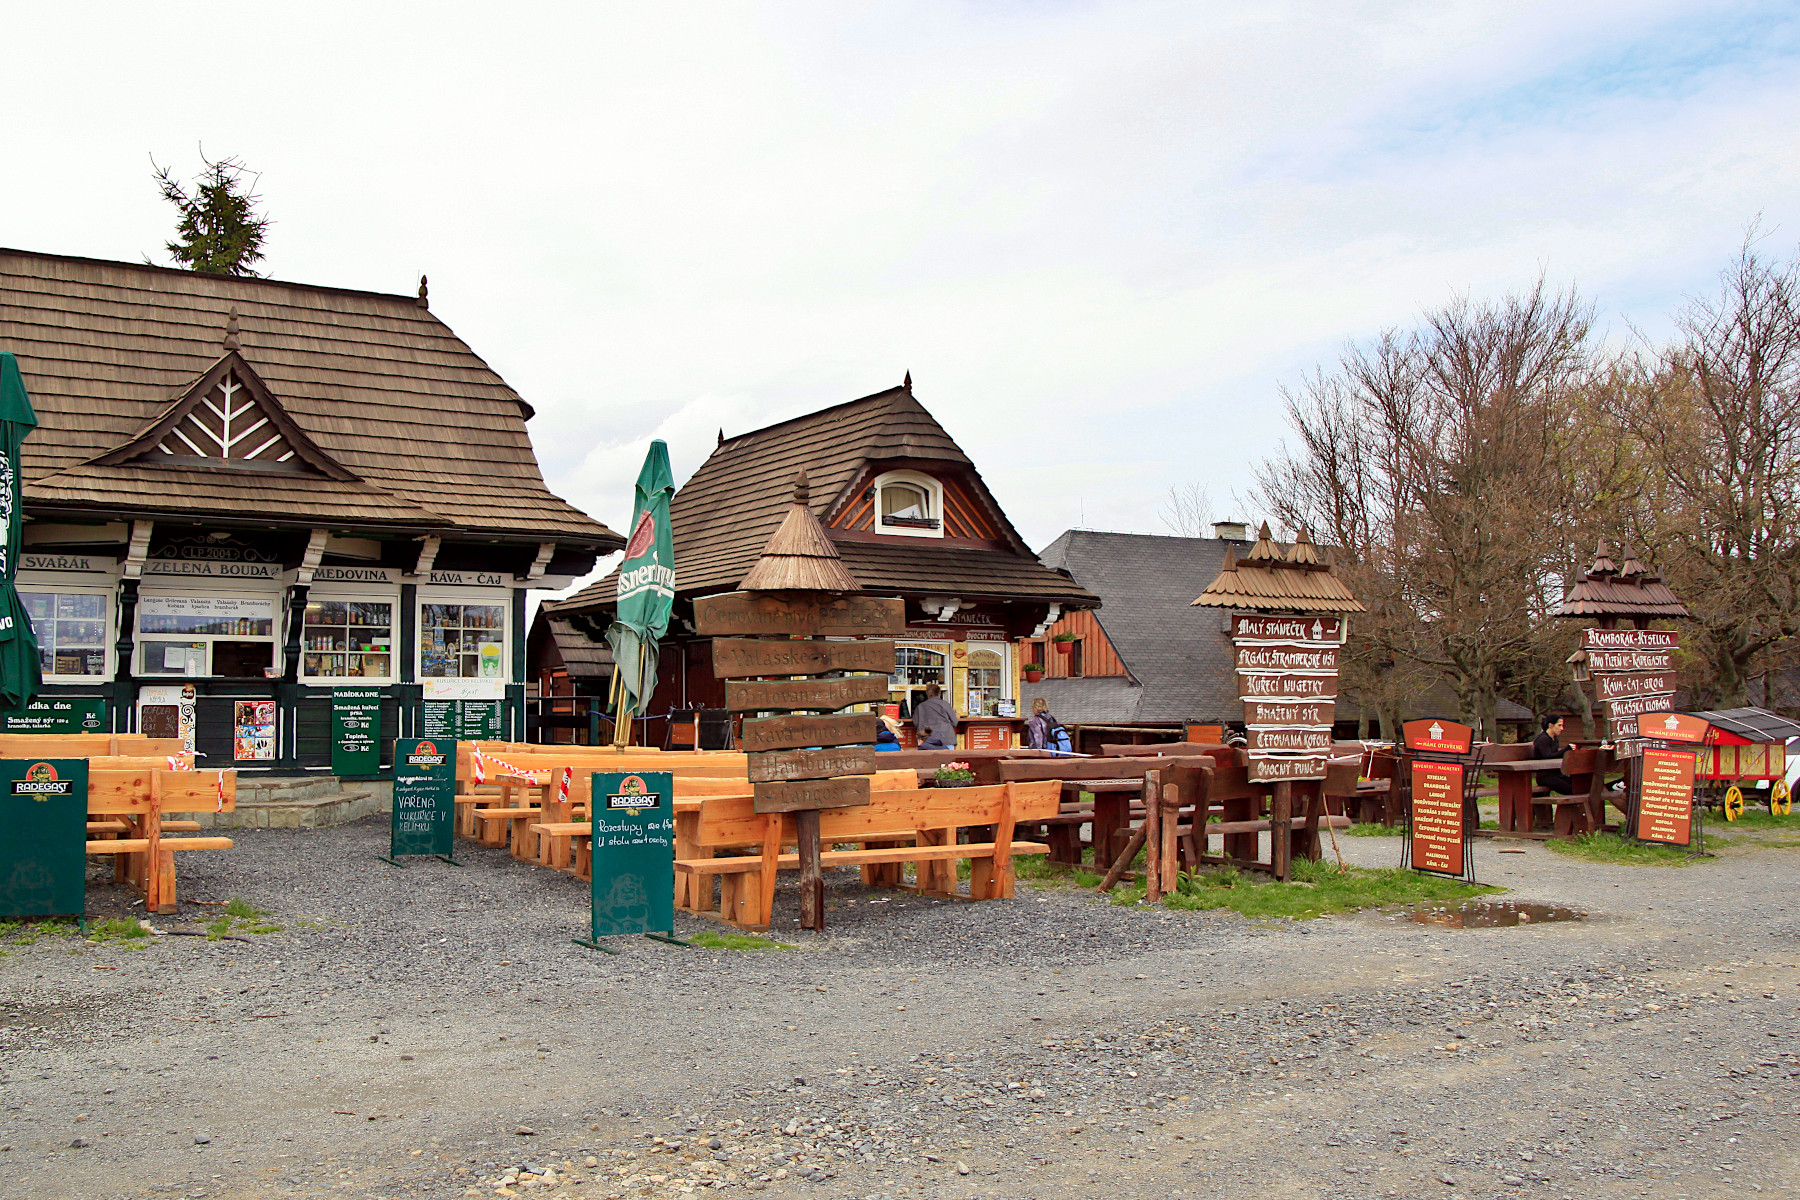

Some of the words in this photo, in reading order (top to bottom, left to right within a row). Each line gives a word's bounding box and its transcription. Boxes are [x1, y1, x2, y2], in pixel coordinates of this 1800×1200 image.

[207, 549, 231, 558] 2004
[25, 555, 90, 569] SVAŘÁK
[151, 562, 212, 574] ZELENÁ
[220, 564, 269, 576] BOUDA
[313, 568, 388, 580] MEDOVINA
[430, 571, 463, 583] KÁVA
[477, 573, 502, 585] ČAJ
[1237, 618, 1264, 635] MALÝ
[1266, 618, 1308, 640] STÁNEČEK
[1322, 651, 1334, 666] UŠI
[1283, 679, 1324, 695] NUGETKY
[333, 690, 364, 698] NABÍDKA
[53, 701, 71, 710] dne
[1302, 704, 1321, 722] SÝR
[7, 717, 41, 725] Smažený
[1256, 730, 1302, 748] ČEPOVANÁ
[1303, 733, 1330, 749] KOFOLA
[408, 755, 444, 765] RADEGAST
[1294, 760, 1315, 775] PUNČ
[16, 782, 69, 793] RADEGAST
[398, 794, 435, 808] VAŘENÁ
[611, 796, 656, 807] RADEGAST
[399, 809, 437, 820] KUKUŘICE
[399, 821, 430, 831] KELÍMKU
[599, 819, 643, 836] Rozestupy
[598, 836, 605, 847] U
[608, 835, 629, 845] stolu
